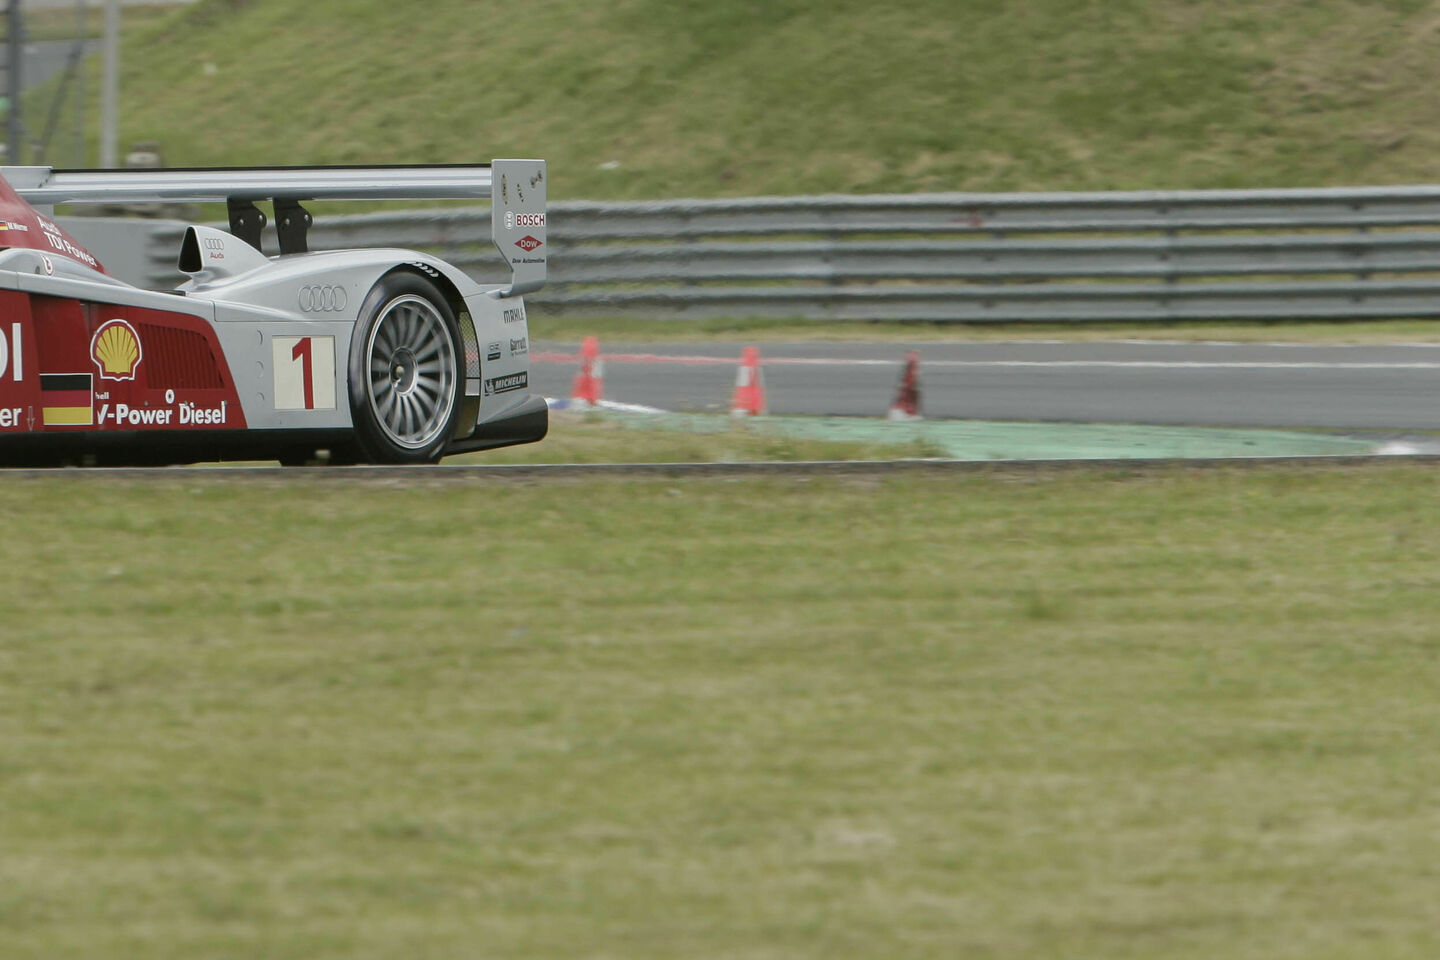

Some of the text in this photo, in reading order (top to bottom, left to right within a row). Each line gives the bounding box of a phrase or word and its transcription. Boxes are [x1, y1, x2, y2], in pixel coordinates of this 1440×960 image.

[37, 215, 63, 237] Audi
[516, 213, 546, 227] BOSCH
[43, 231, 66, 252] TDI
[291, 336, 315, 410] 1
[494, 374, 527, 390] MICHELIN
[97, 400, 226, 425] V-Power Diesel
